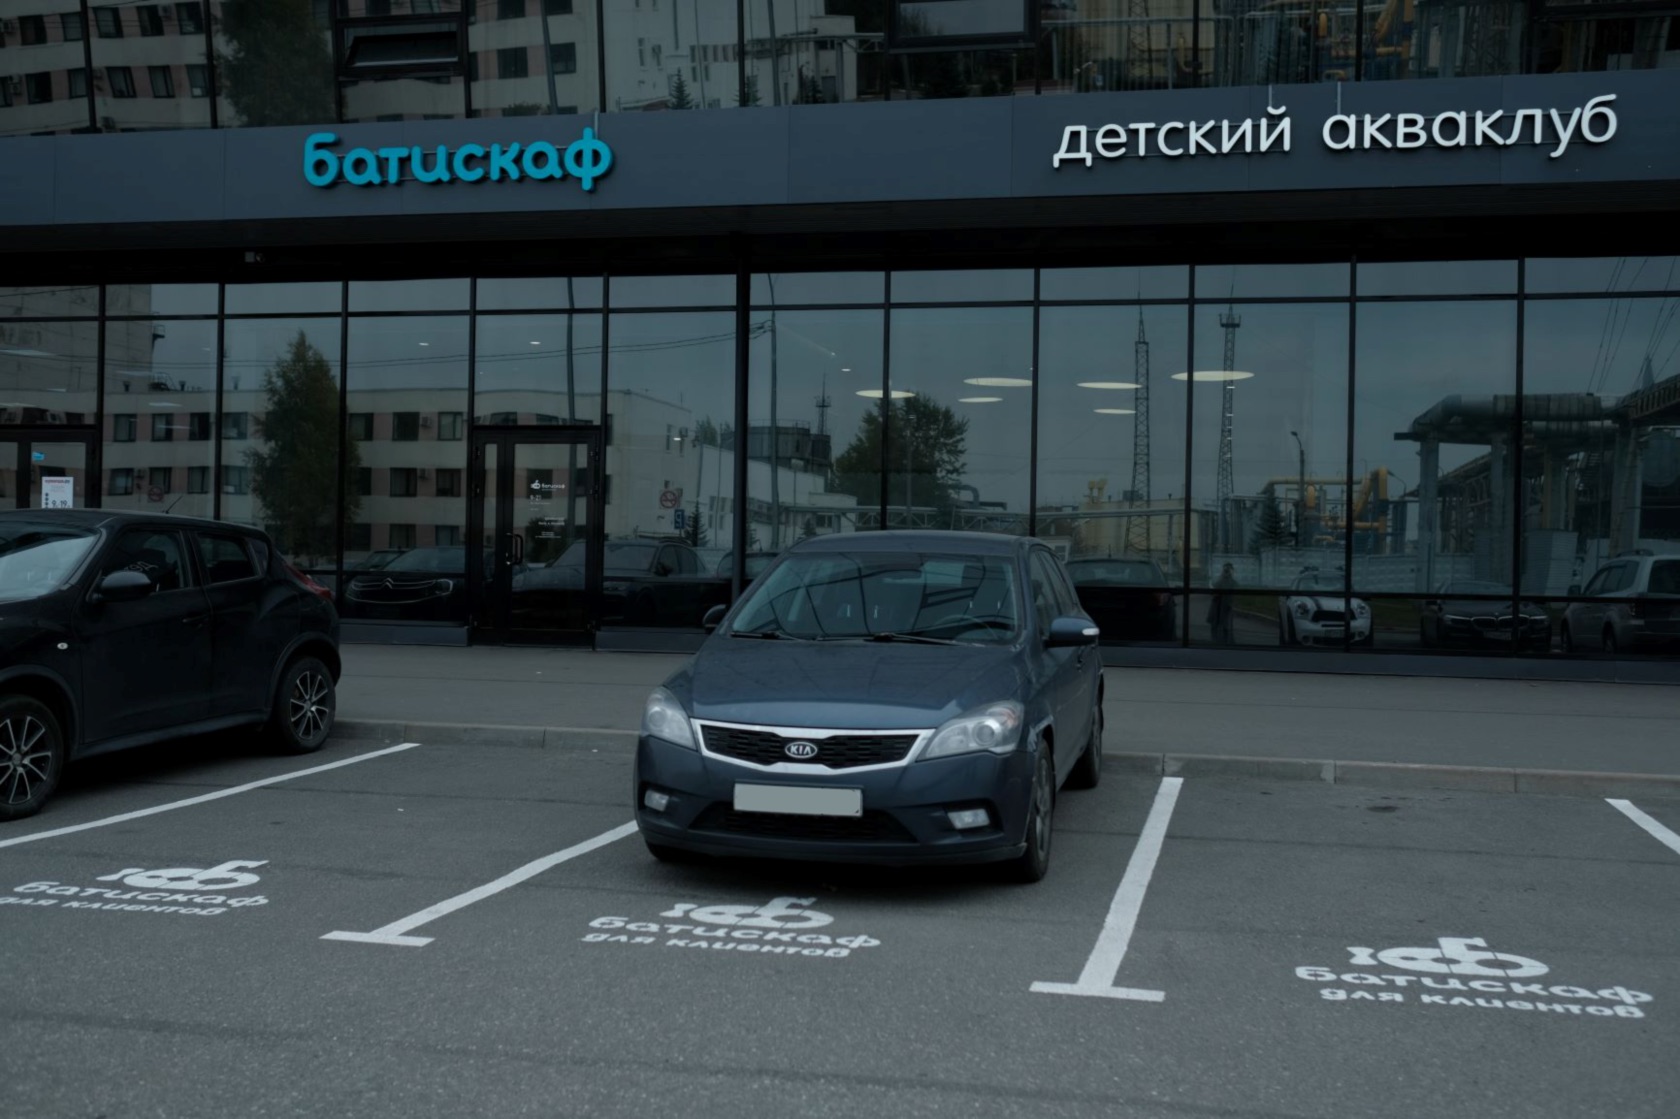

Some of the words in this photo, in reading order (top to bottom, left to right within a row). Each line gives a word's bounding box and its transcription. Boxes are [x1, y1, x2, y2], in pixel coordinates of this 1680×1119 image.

[1053, 105, 1291, 168] детский
[1322, 93, 1618, 158] акваклуб
[303, 126, 614, 191] батискаф
[790, 744, 812, 755] KIA
[0, 896, 58, 906] для
[62, 901, 228, 916] клиентов
[13, 881, 269, 907] батискаф
[580, 932, 656, 945] для
[665, 938, 850, 958] клиентов
[588, 916, 881, 948] батискаф
[1295, 966, 1653, 1005] батискаф
[1320, 987, 1404, 1002] для
[1420, 994, 1645, 1018] клиентов
